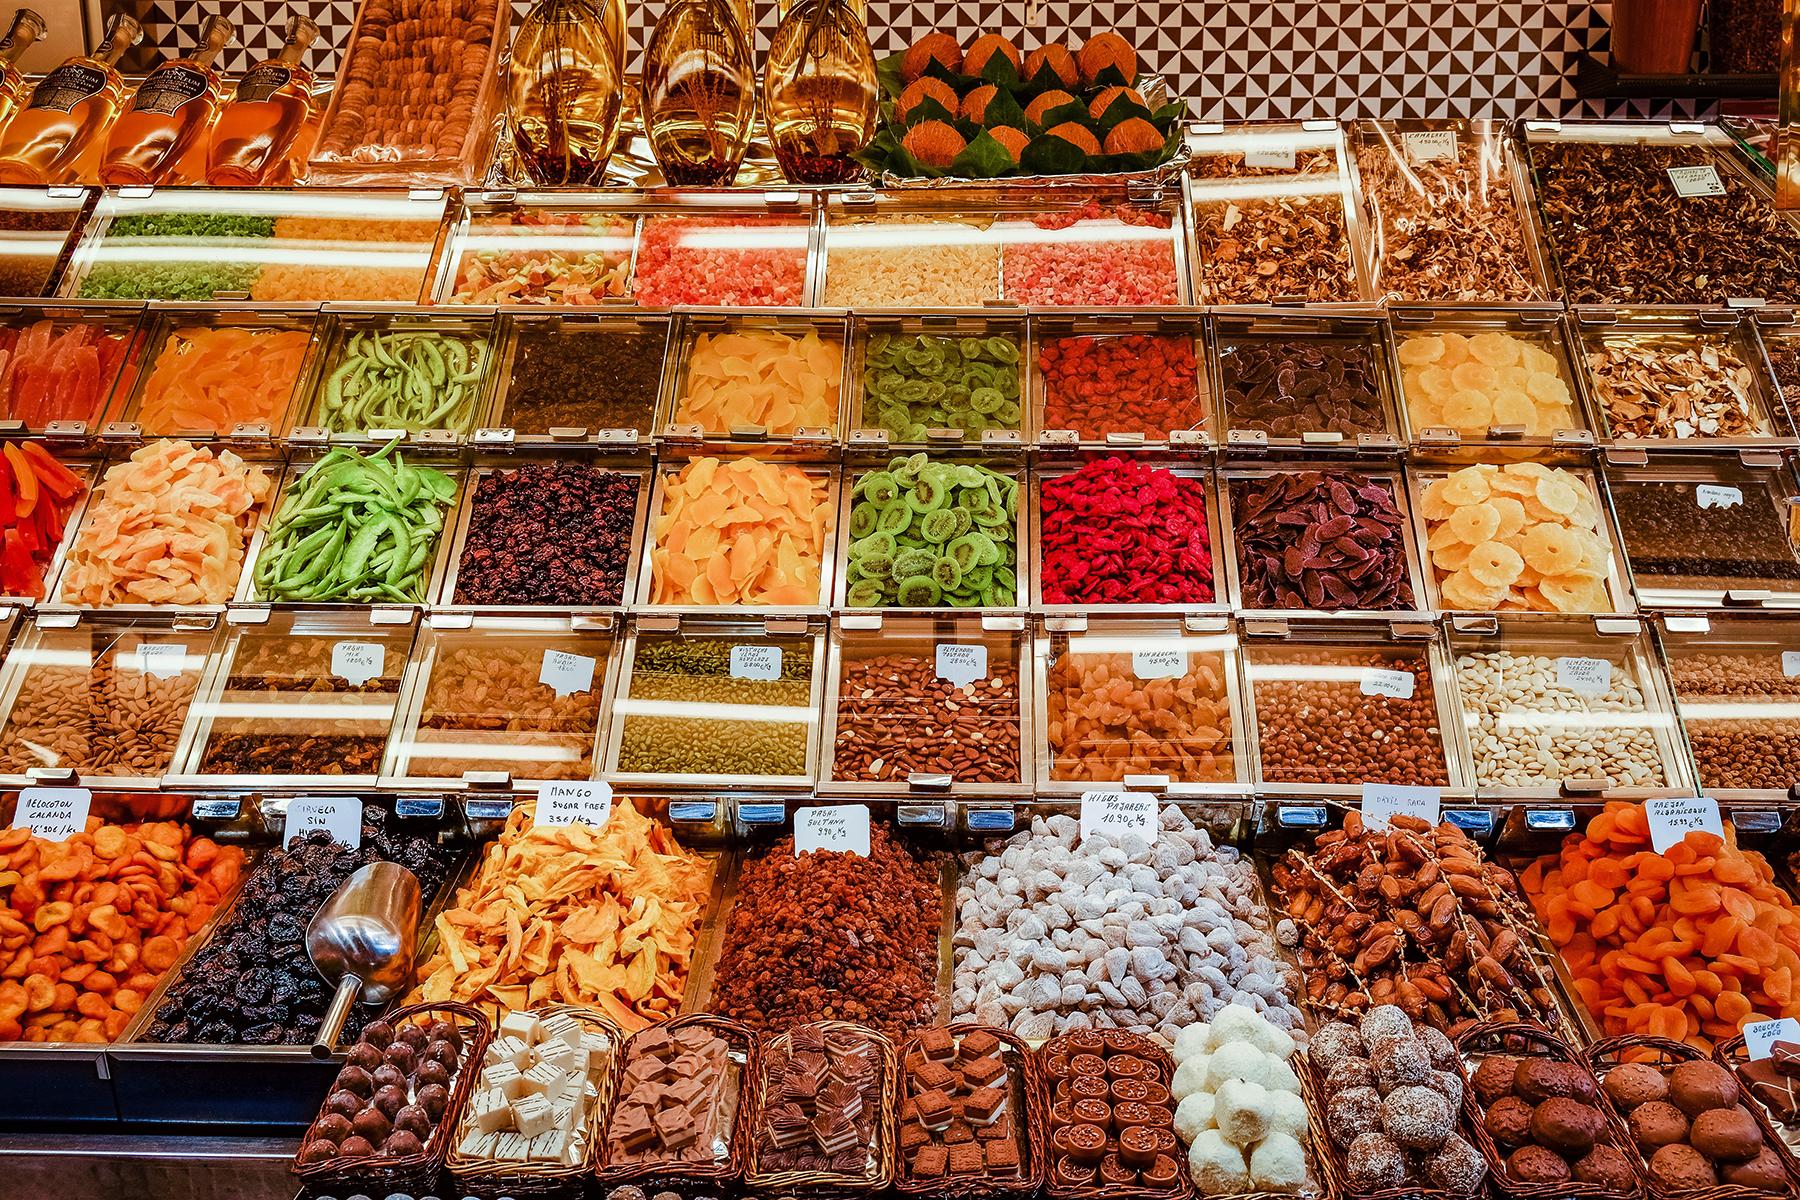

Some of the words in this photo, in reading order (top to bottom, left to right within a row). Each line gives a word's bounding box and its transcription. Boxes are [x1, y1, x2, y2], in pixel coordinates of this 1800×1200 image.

[550, 786, 593, 798] MANGO
[1088, 793, 1120, 803] HIGOS
[552, 800, 580, 810] SUGAR
[584, 802, 607, 811] FREE
[28, 811, 73, 819] CALANDA
[307, 816, 326, 825] SIN
[807, 818, 846, 827] SULTANA
